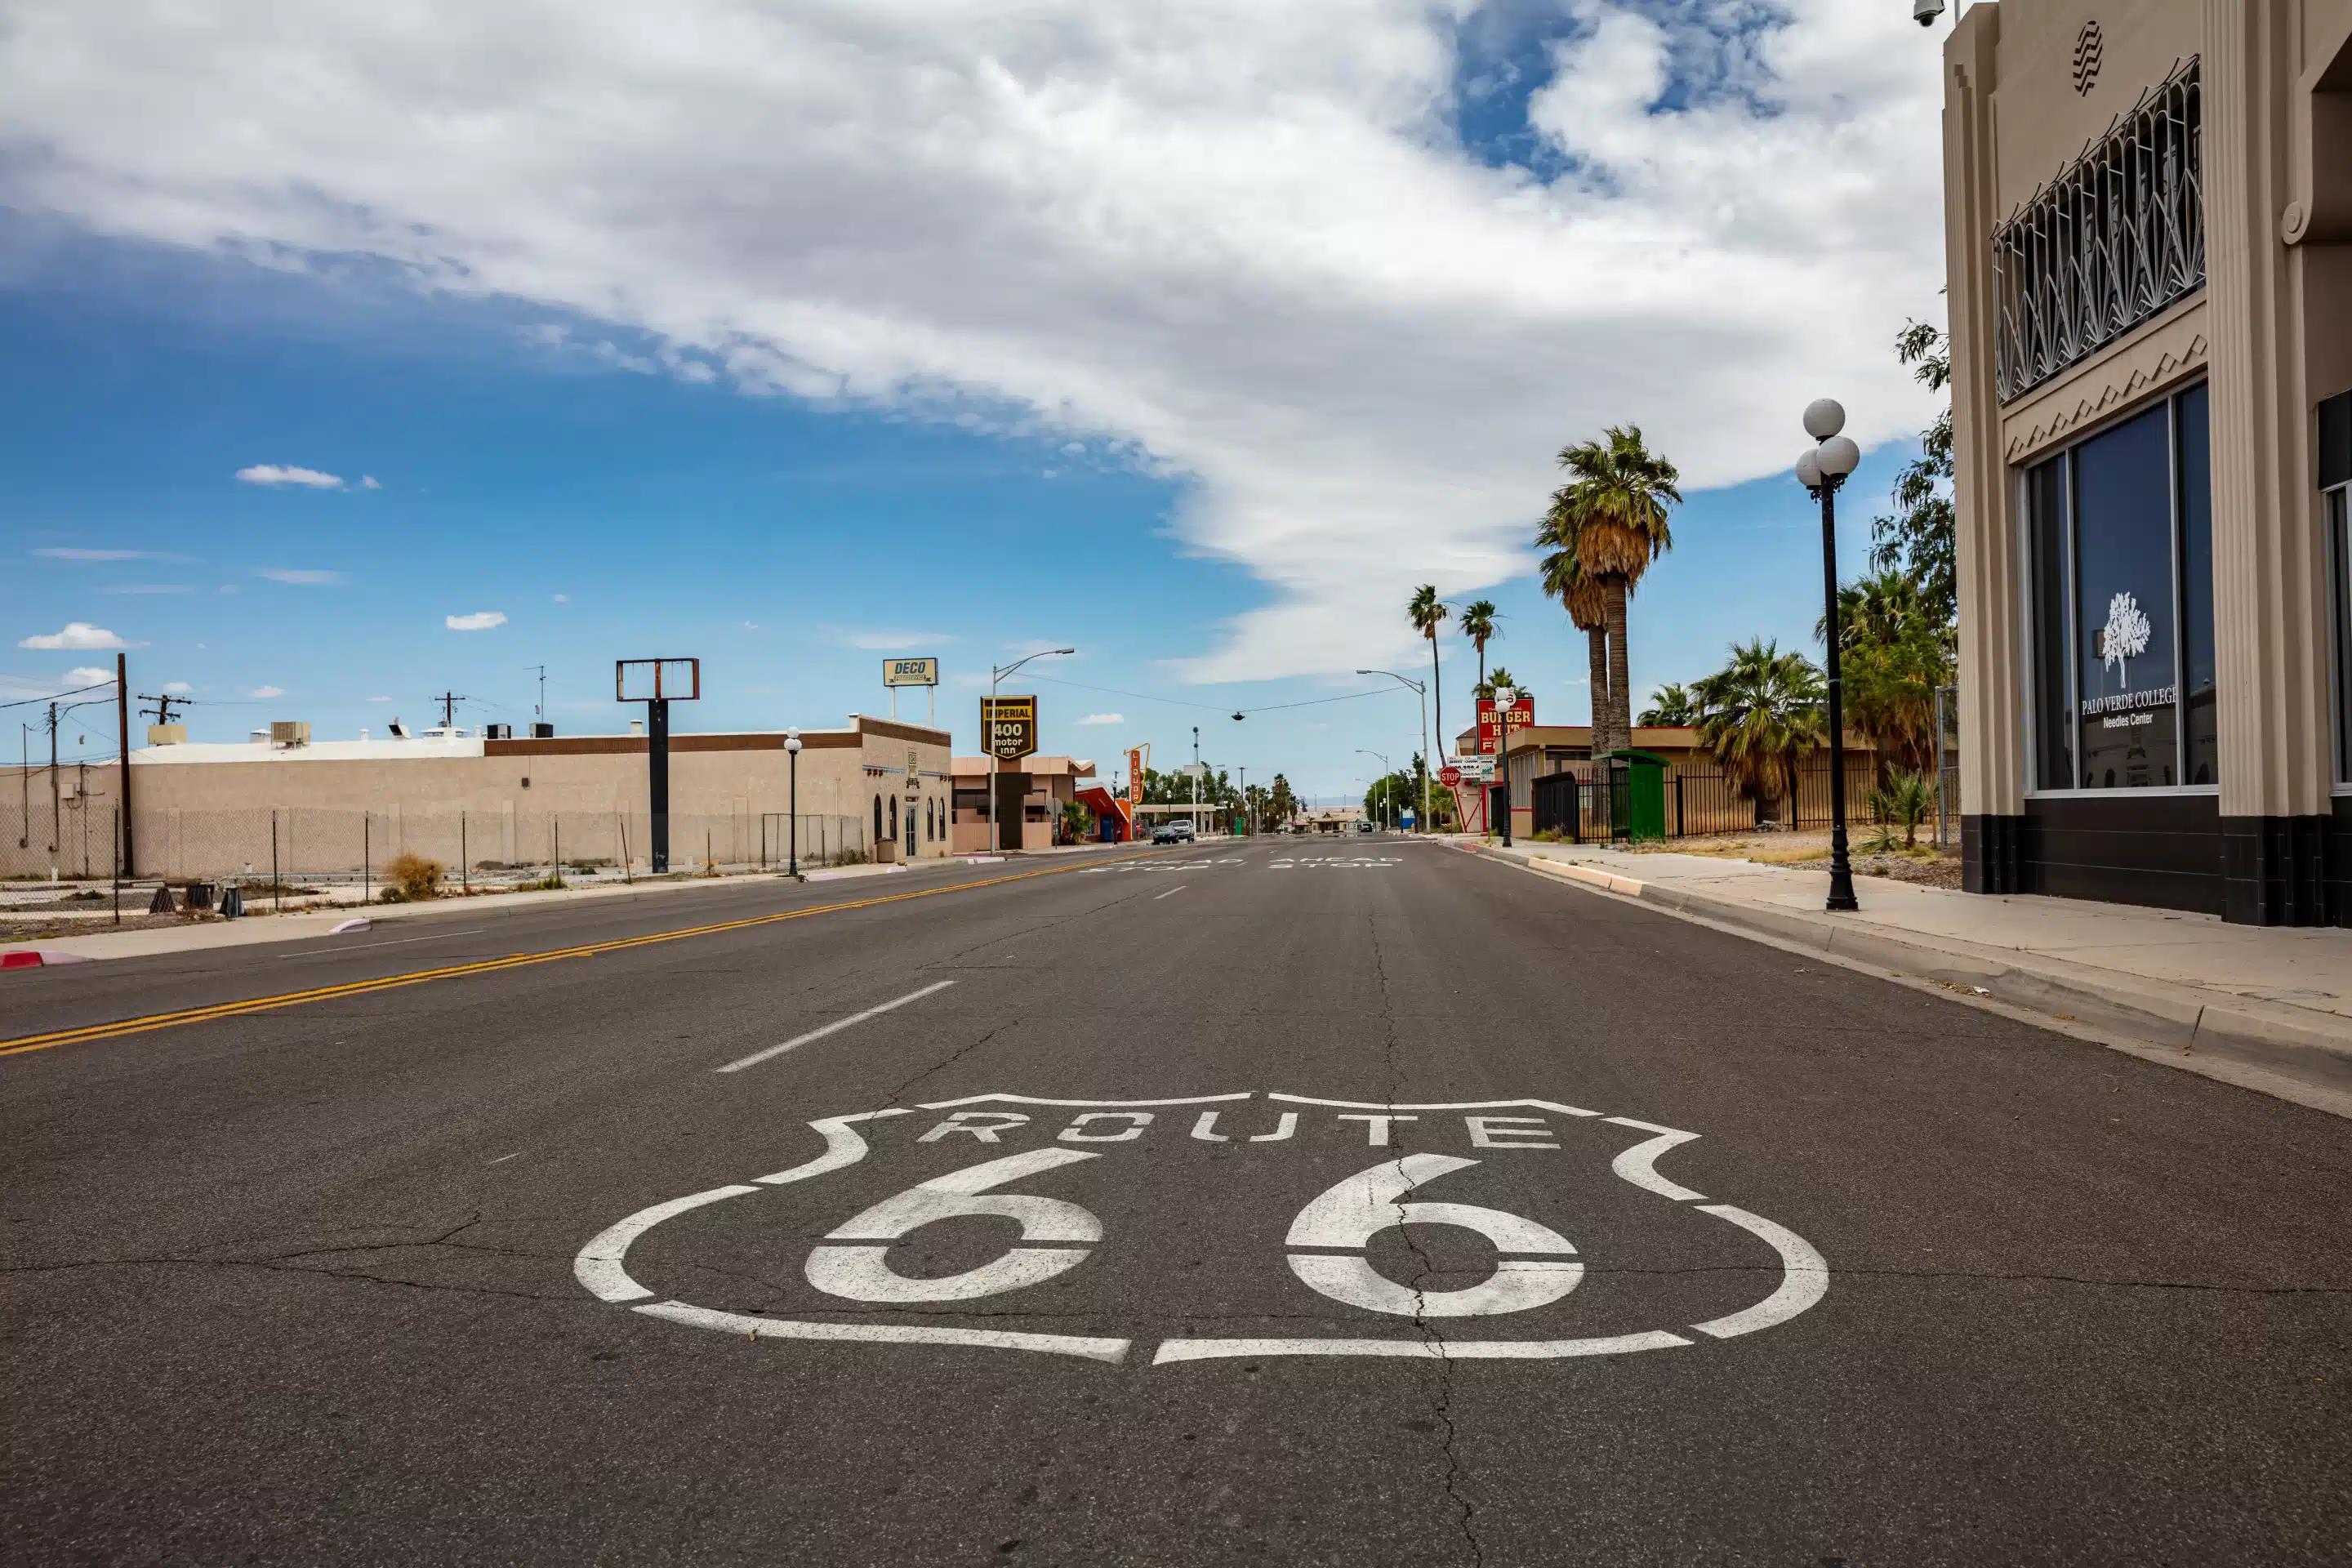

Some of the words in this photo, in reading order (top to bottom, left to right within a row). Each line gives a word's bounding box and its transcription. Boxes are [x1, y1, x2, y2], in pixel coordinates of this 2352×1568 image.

[895, 662, 926, 674] DECO
[2082, 697, 2104, 715] PALO
[2105, 693, 2134, 712] VERDE
[2104, 715, 2129, 728] Needles
[2130, 713, 2154, 725] Center
[995, 724, 1022, 737] 400
[994, 737, 1023, 746] motor
[1000, 746, 1016, 755] inn
[1441, 773, 1460, 782] STOP
[916, 1111, 1561, 1150] ROUTE
[804, 1147, 1585, 1318] 66
